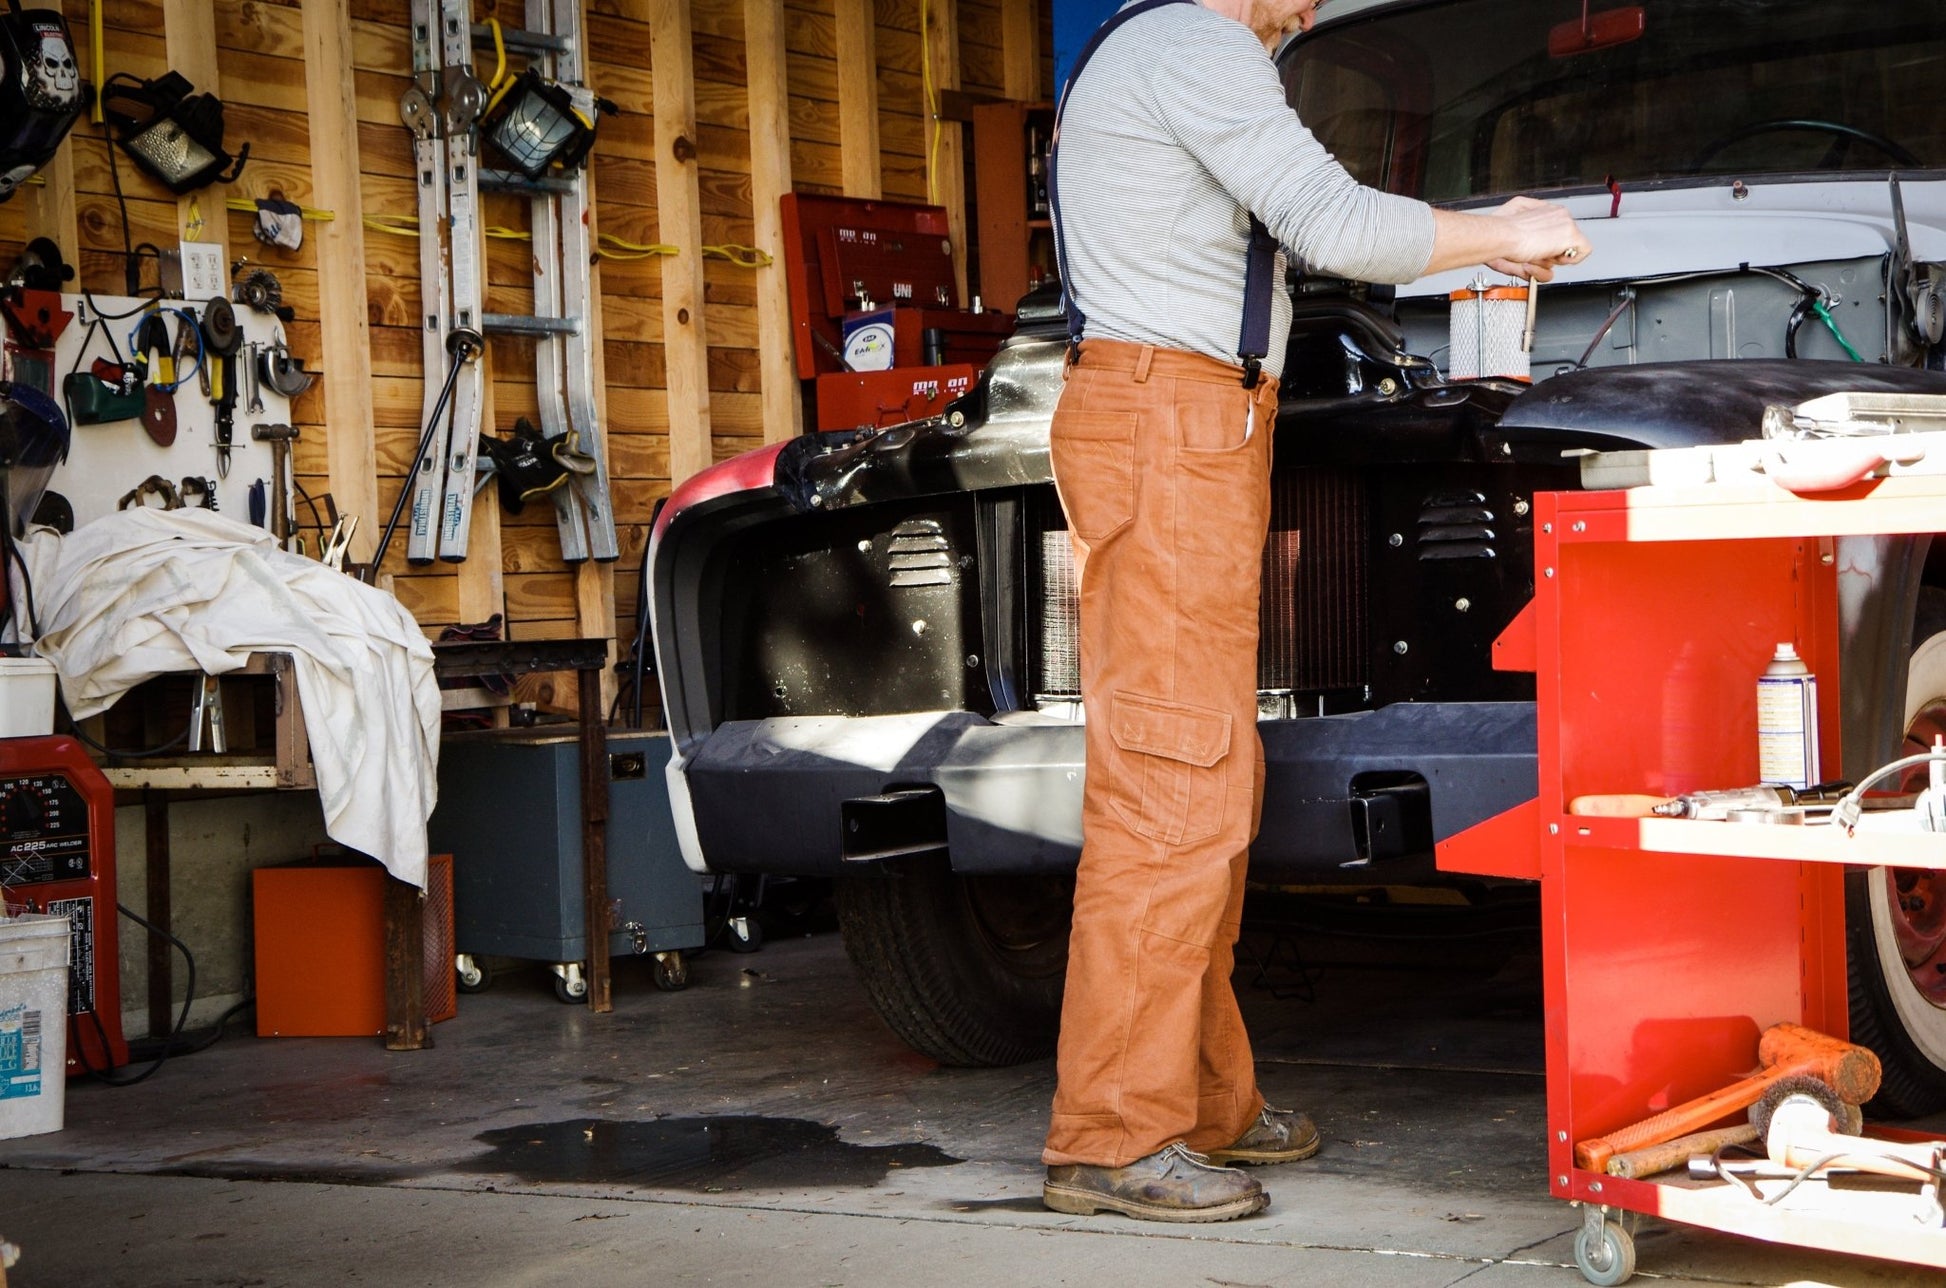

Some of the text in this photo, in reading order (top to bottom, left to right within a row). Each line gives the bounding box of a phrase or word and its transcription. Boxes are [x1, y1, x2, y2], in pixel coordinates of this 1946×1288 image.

[893, 283, 912, 298] UNI
[416, 489, 430, 535] INDUSTRIAL
[443, 494, 458, 540] INDUSTRIAL
[24, 841, 46, 851] 225
